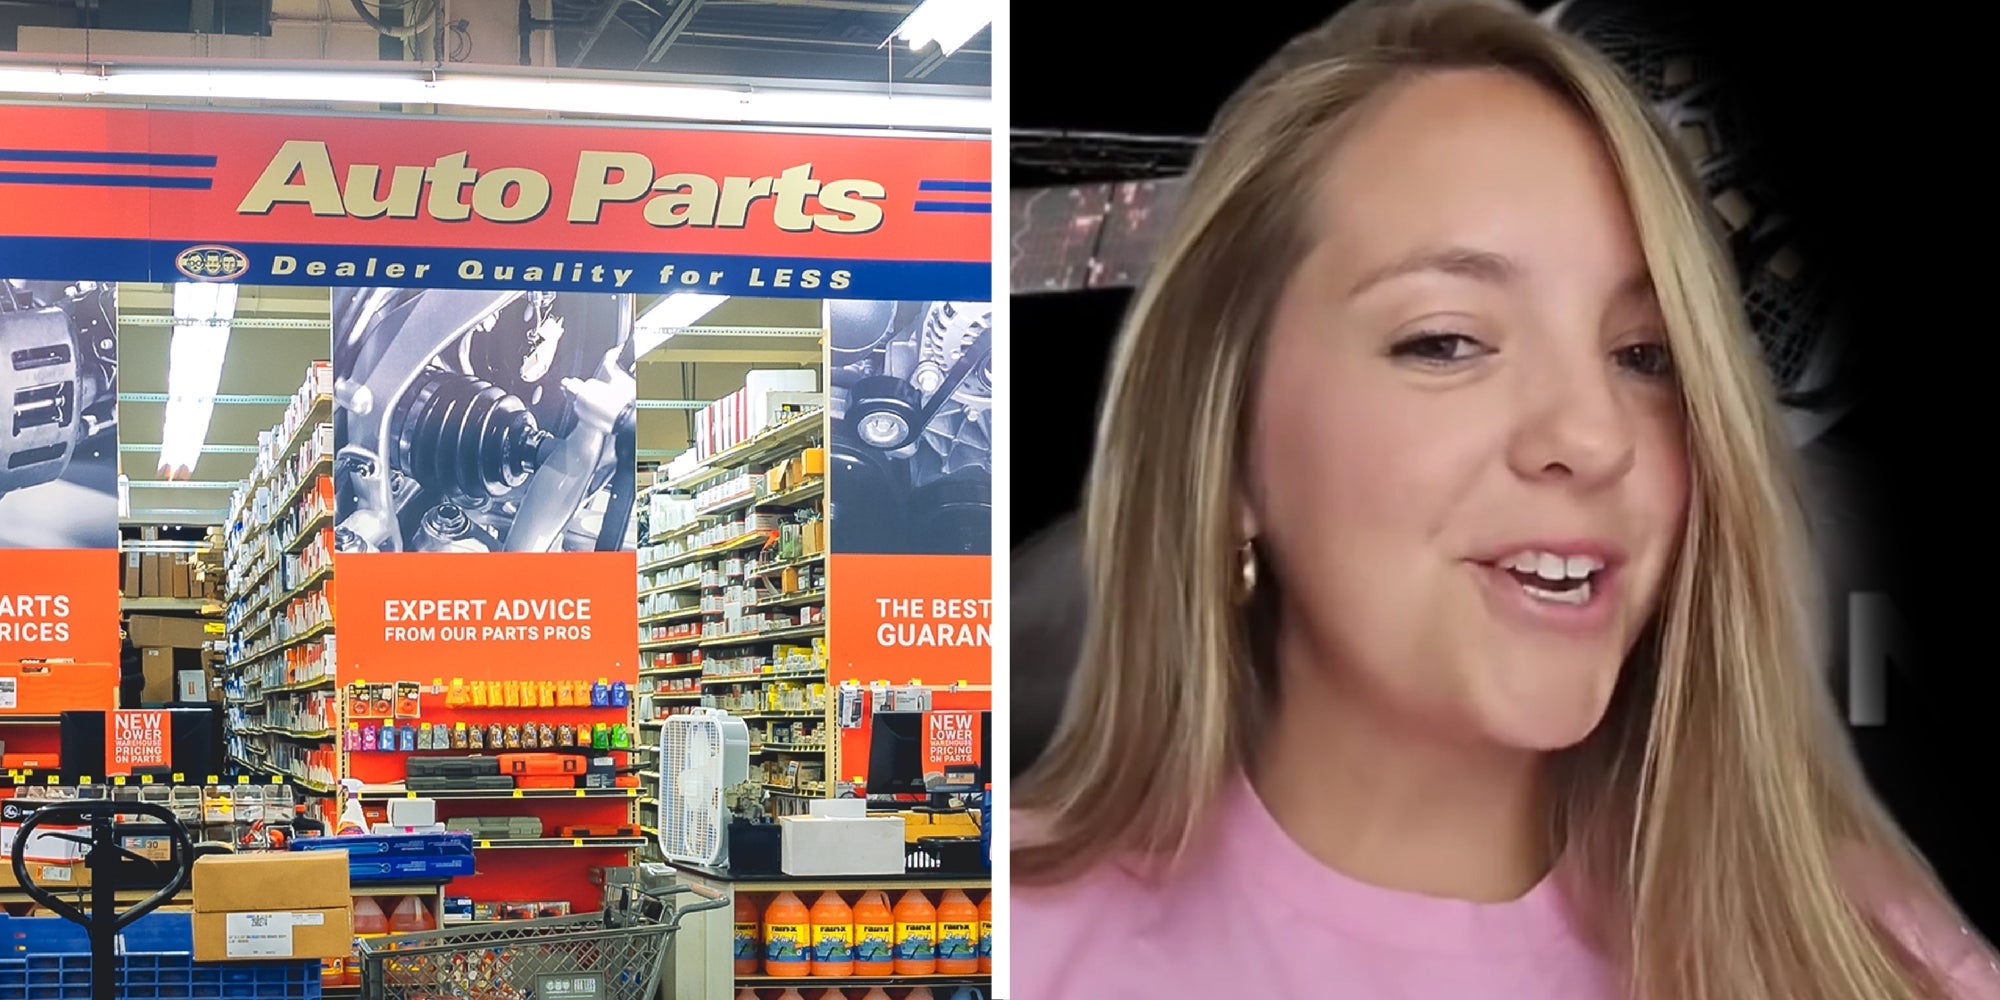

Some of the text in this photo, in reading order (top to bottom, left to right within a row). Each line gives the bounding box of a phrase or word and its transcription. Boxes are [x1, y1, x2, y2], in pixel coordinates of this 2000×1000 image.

[236, 140, 887, 233] Auto Parts
[271, 256, 852, 289] Dealer Quality for LESS
[0, 595, 70, 617] ARTS
[384, 598, 591, 621] EXPERT ADVICE
[876, 598, 992, 619] THE BEST
[0, 622, 70, 641] RICES
[384, 625, 591, 641] FROM OUR PARTS PROS
[877, 622, 992, 647] GUARAN
[115, 713, 162, 729] NEW
[930, 714, 973, 730] NEW
[115, 729, 162, 740] LOWER
[930, 729, 973, 740] LOWER
[115, 746, 162, 756] PRICING
[930, 746, 973, 756] PRICING
[930, 754, 973, 763] ON PARTS
[115, 755, 162, 764] ON PARTS
